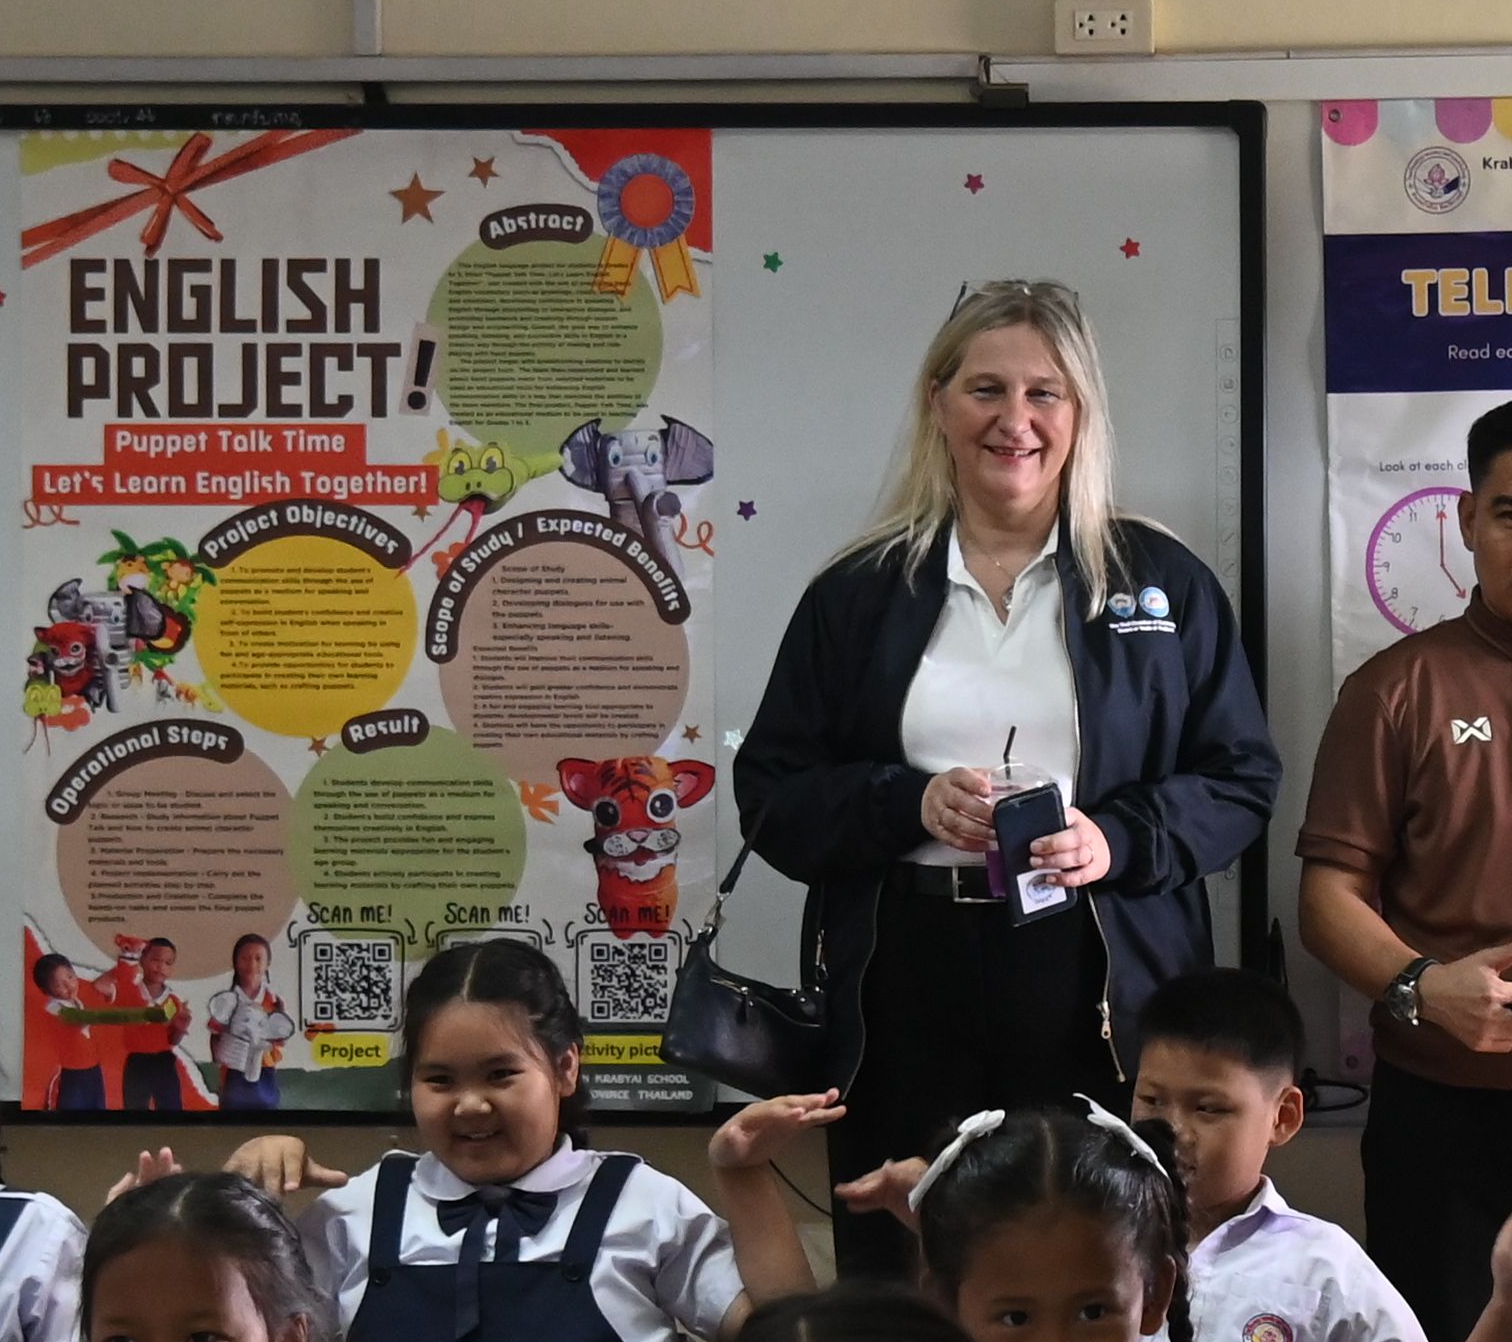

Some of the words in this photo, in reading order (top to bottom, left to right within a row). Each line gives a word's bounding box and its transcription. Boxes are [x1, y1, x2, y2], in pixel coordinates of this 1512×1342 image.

[488, 212, 585, 239] Abstract
[70, 258, 380, 334] ENGLISH
[1449, 344, 1489, 358] Read
[67, 339, 438, 418] PROJECT!
[116, 431, 207, 457] Puppet
[218, 430, 272, 452] Talk
[283, 429, 344, 452] Time
[1379, 461, 1405, 472] Look
[1425, 462, 1450, 471] each
[44, 471, 103, 493] Let's
[115, 472, 185, 493] Learn
[196, 471, 290, 499] English
[301, 471, 426, 499] Together!
[204, 511, 280, 558] Project
[286, 506, 398, 556] Objectives
[430, 596, 458, 655] Scope
[448, 569, 466, 593] of
[461, 533, 513, 573] Study
[536, 517, 626, 549] Expected
[626, 539, 681, 611] Benefits
[349, 715, 420, 743] Result
[52, 726, 160, 815] Operational
[168, 726, 229, 751] Steps
[308, 902, 352, 923] SCAN
[360, 905, 391, 923] ME!
[444, 902, 490, 924] SCAN
[497, 905, 529, 923] ME!
[320, 1044, 381, 1061] Project
